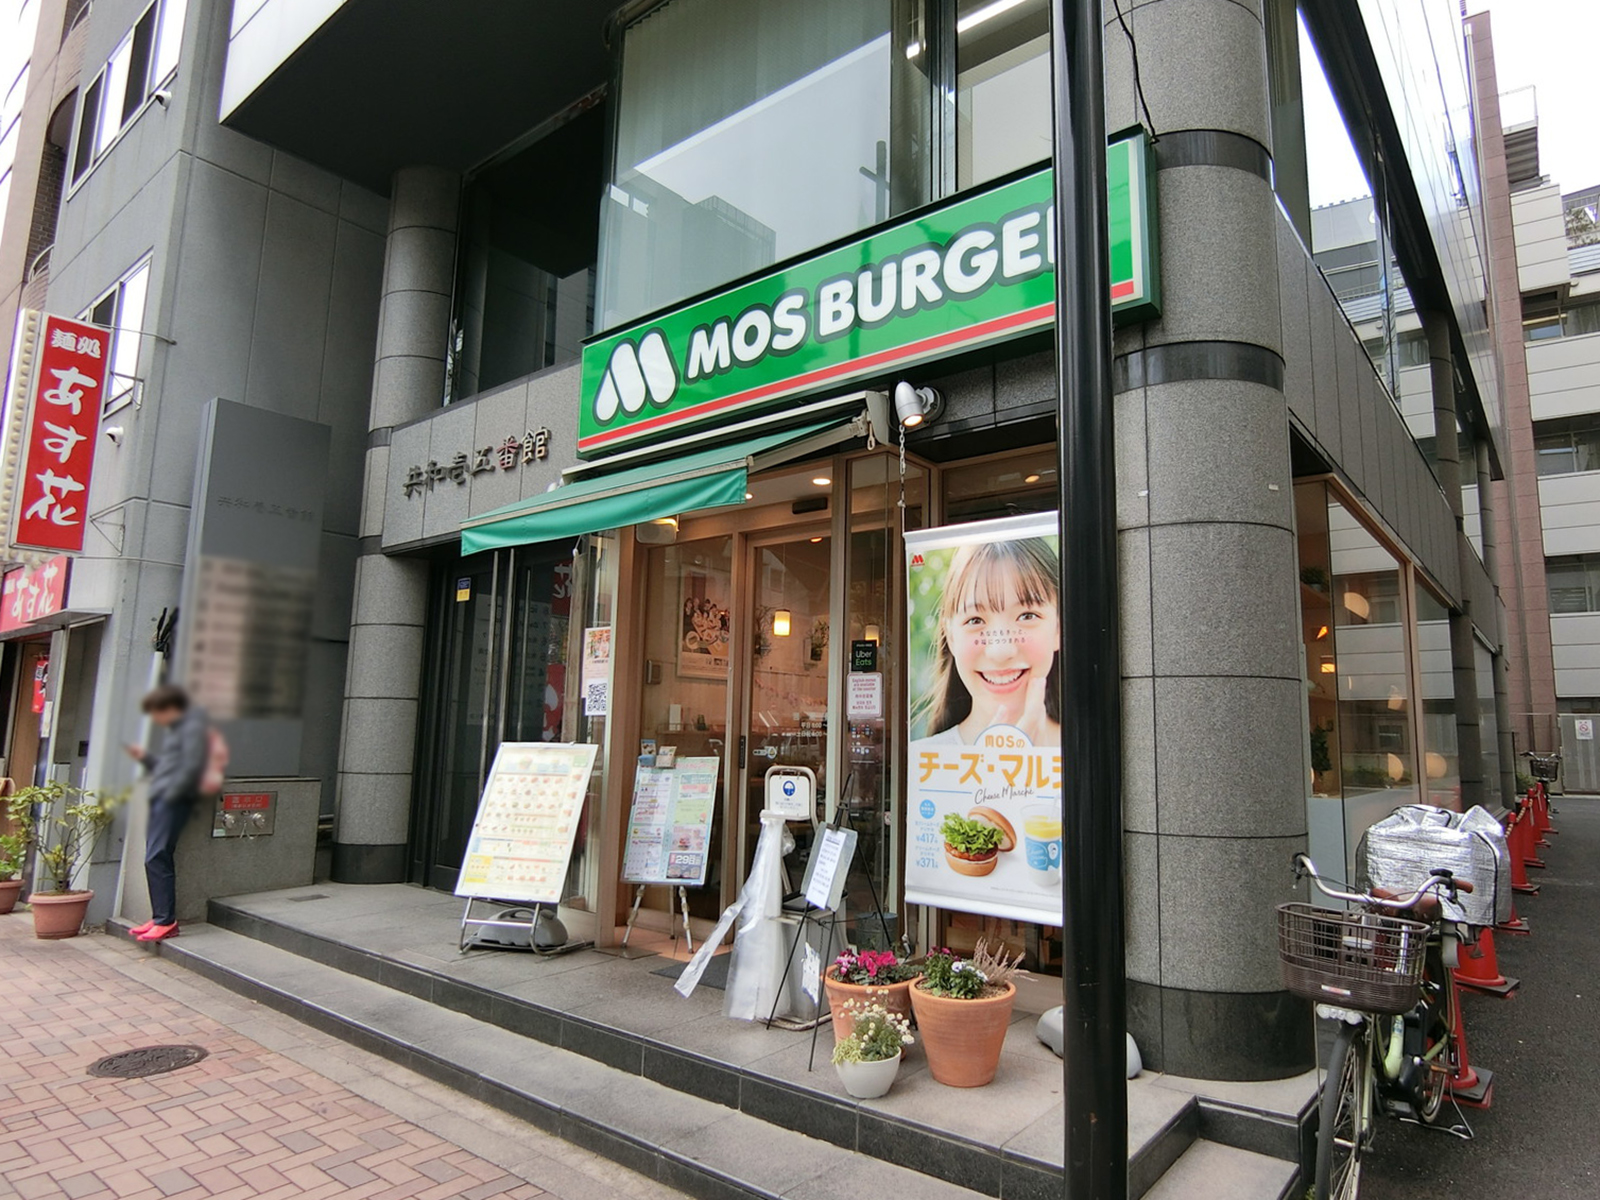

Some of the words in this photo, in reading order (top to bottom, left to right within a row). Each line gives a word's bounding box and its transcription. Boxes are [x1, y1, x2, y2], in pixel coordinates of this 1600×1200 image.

[687, 294, 806, 379] MOS
[25, 366, 98, 526] あす花
